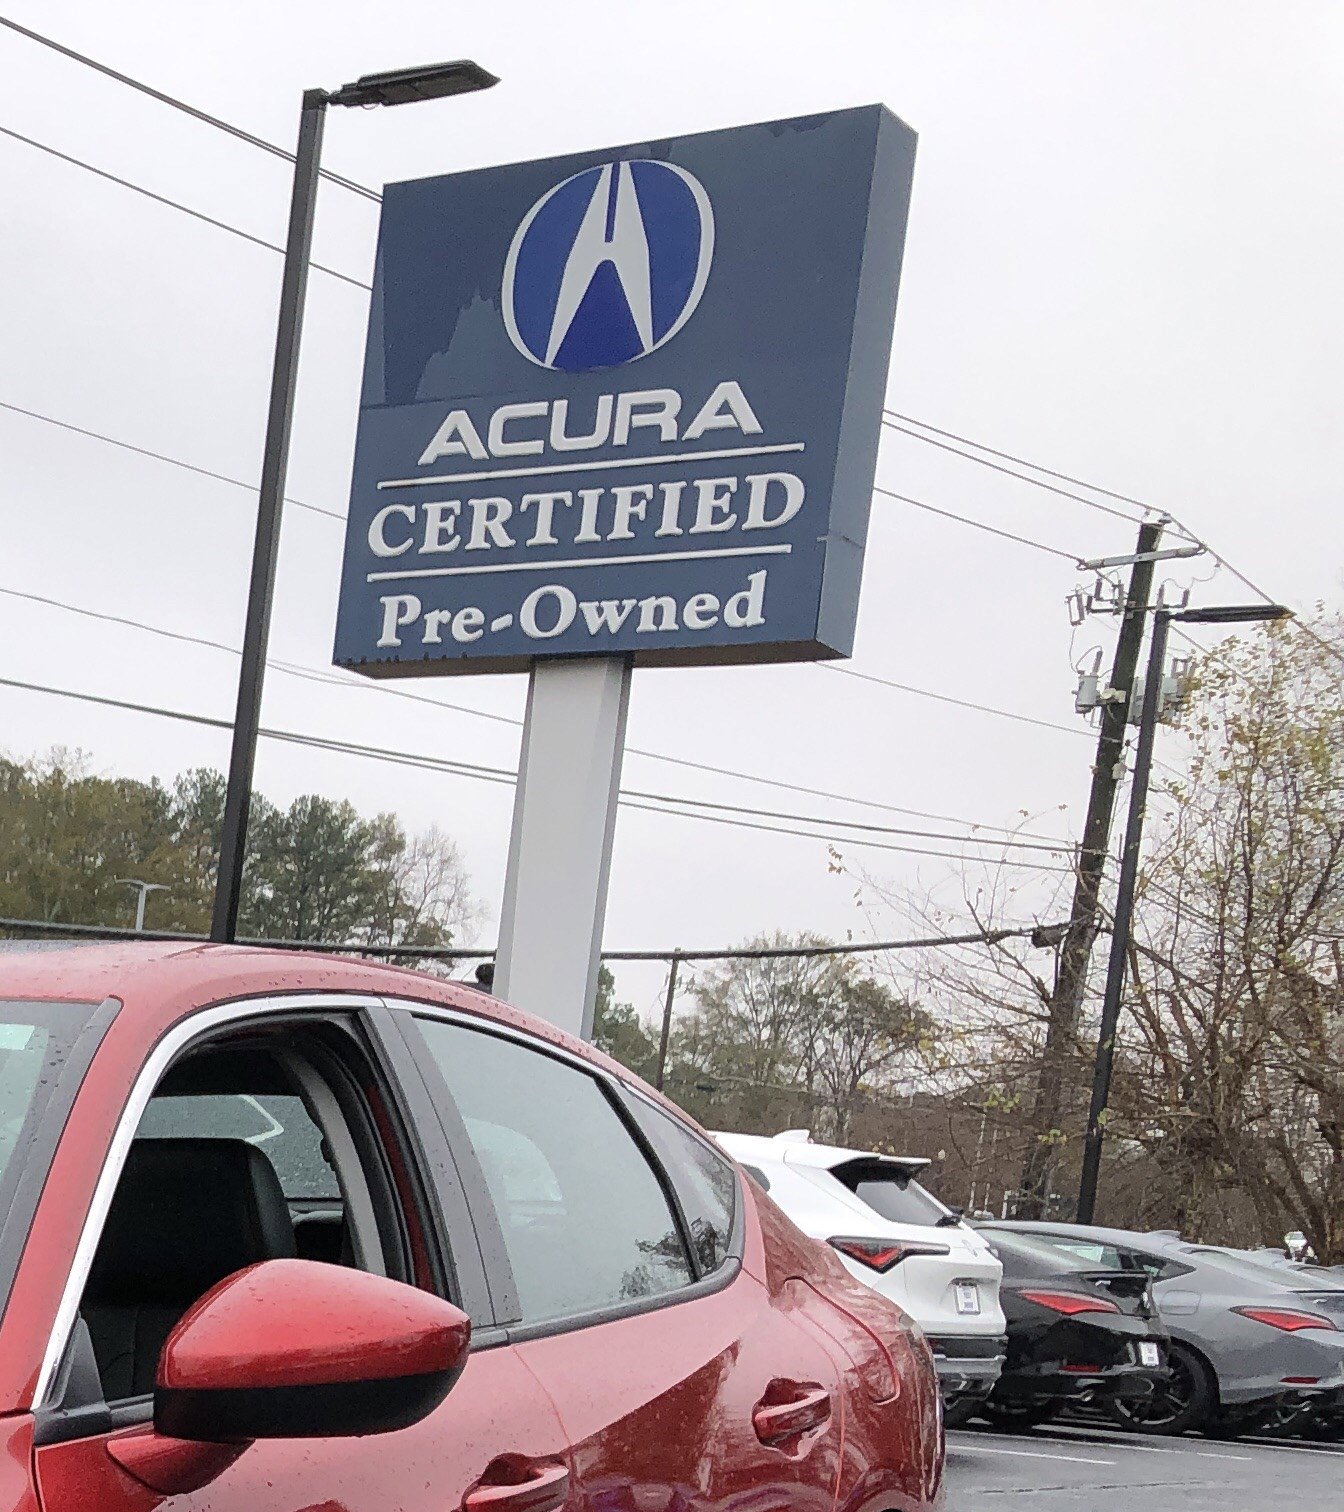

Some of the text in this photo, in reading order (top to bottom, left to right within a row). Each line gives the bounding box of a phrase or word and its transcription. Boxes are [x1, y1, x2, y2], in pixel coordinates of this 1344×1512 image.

[418, 380, 764, 466] ACURA
[367, 472, 806, 558] CERTIFIED
[376, 569, 767, 648] Pre-Owned
